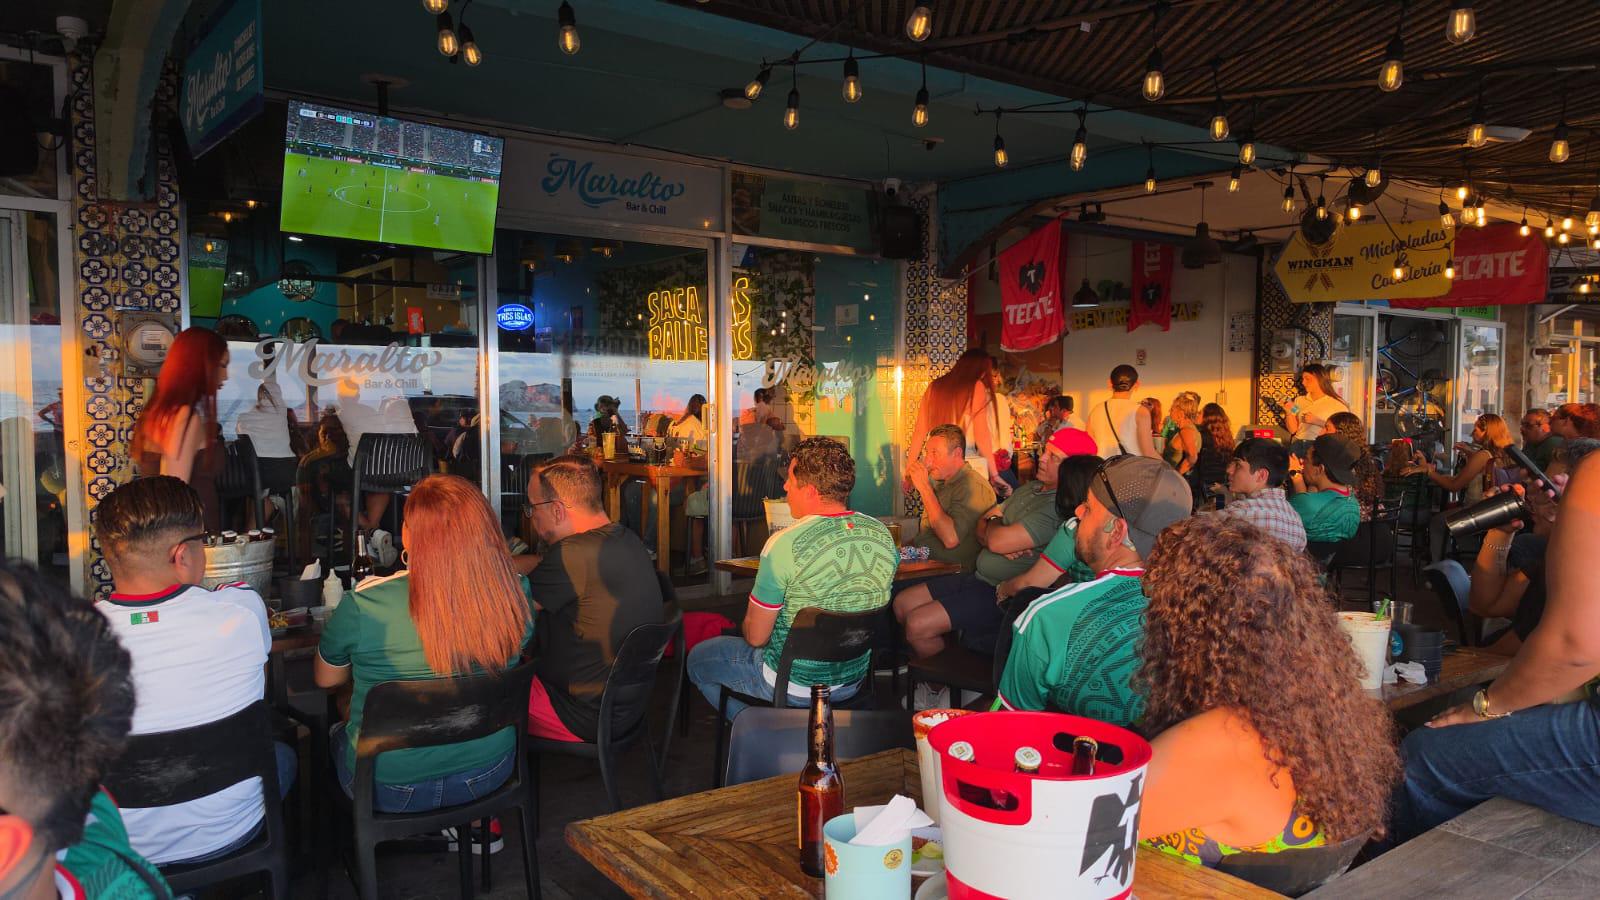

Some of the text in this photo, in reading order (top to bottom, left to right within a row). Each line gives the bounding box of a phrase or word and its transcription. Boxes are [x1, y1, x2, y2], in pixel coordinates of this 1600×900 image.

[541, 155, 685, 206] Maralto
[626, 201, 640, 211] Bar
[649, 205, 666, 215] Chill
[1288, 256, 1354, 269] WINGMAN
[1454, 250, 1528, 281] ECATE
[497, 311, 532, 322] TRES ISLAS
[648, 286, 702, 326] SACA
[248, 337, 443, 387] Maralto
[364, 379, 418, 389] Bar & Chill
